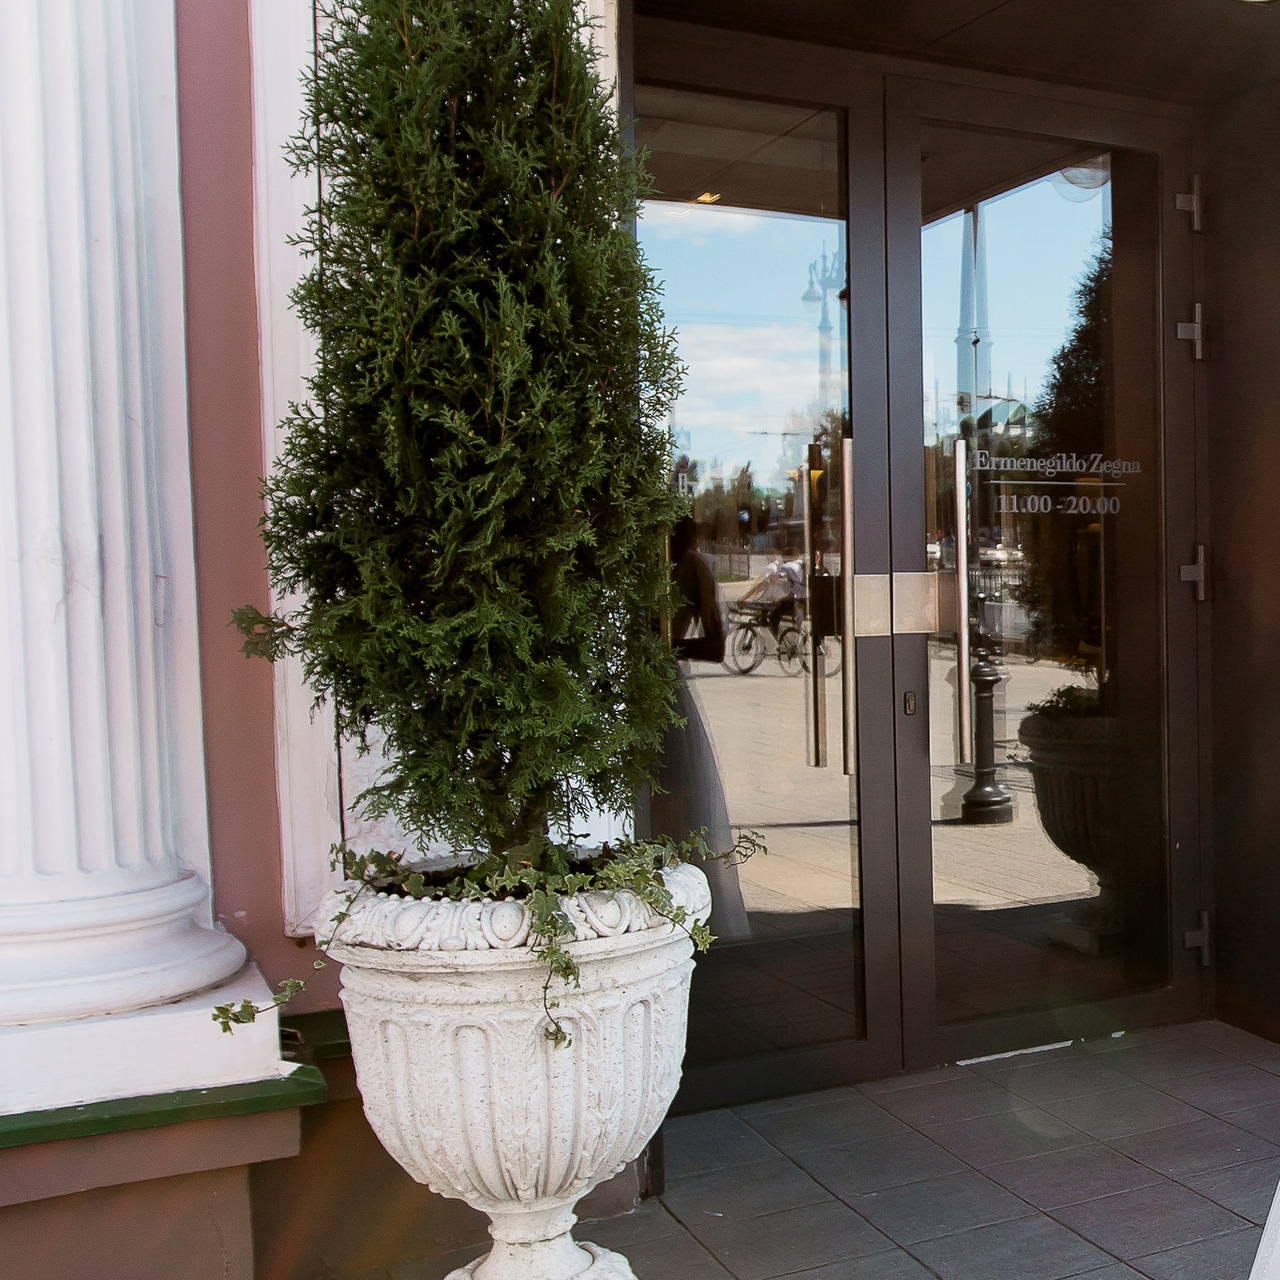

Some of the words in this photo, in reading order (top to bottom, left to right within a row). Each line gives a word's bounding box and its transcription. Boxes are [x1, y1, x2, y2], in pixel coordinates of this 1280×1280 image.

[972, 450, 1086, 476] Ermenegildo
[1090, 453, 1141, 478] Zegna
[998, 494, 1051, 513] 11.00
[1067, 495, 1120, 514] 20.00
